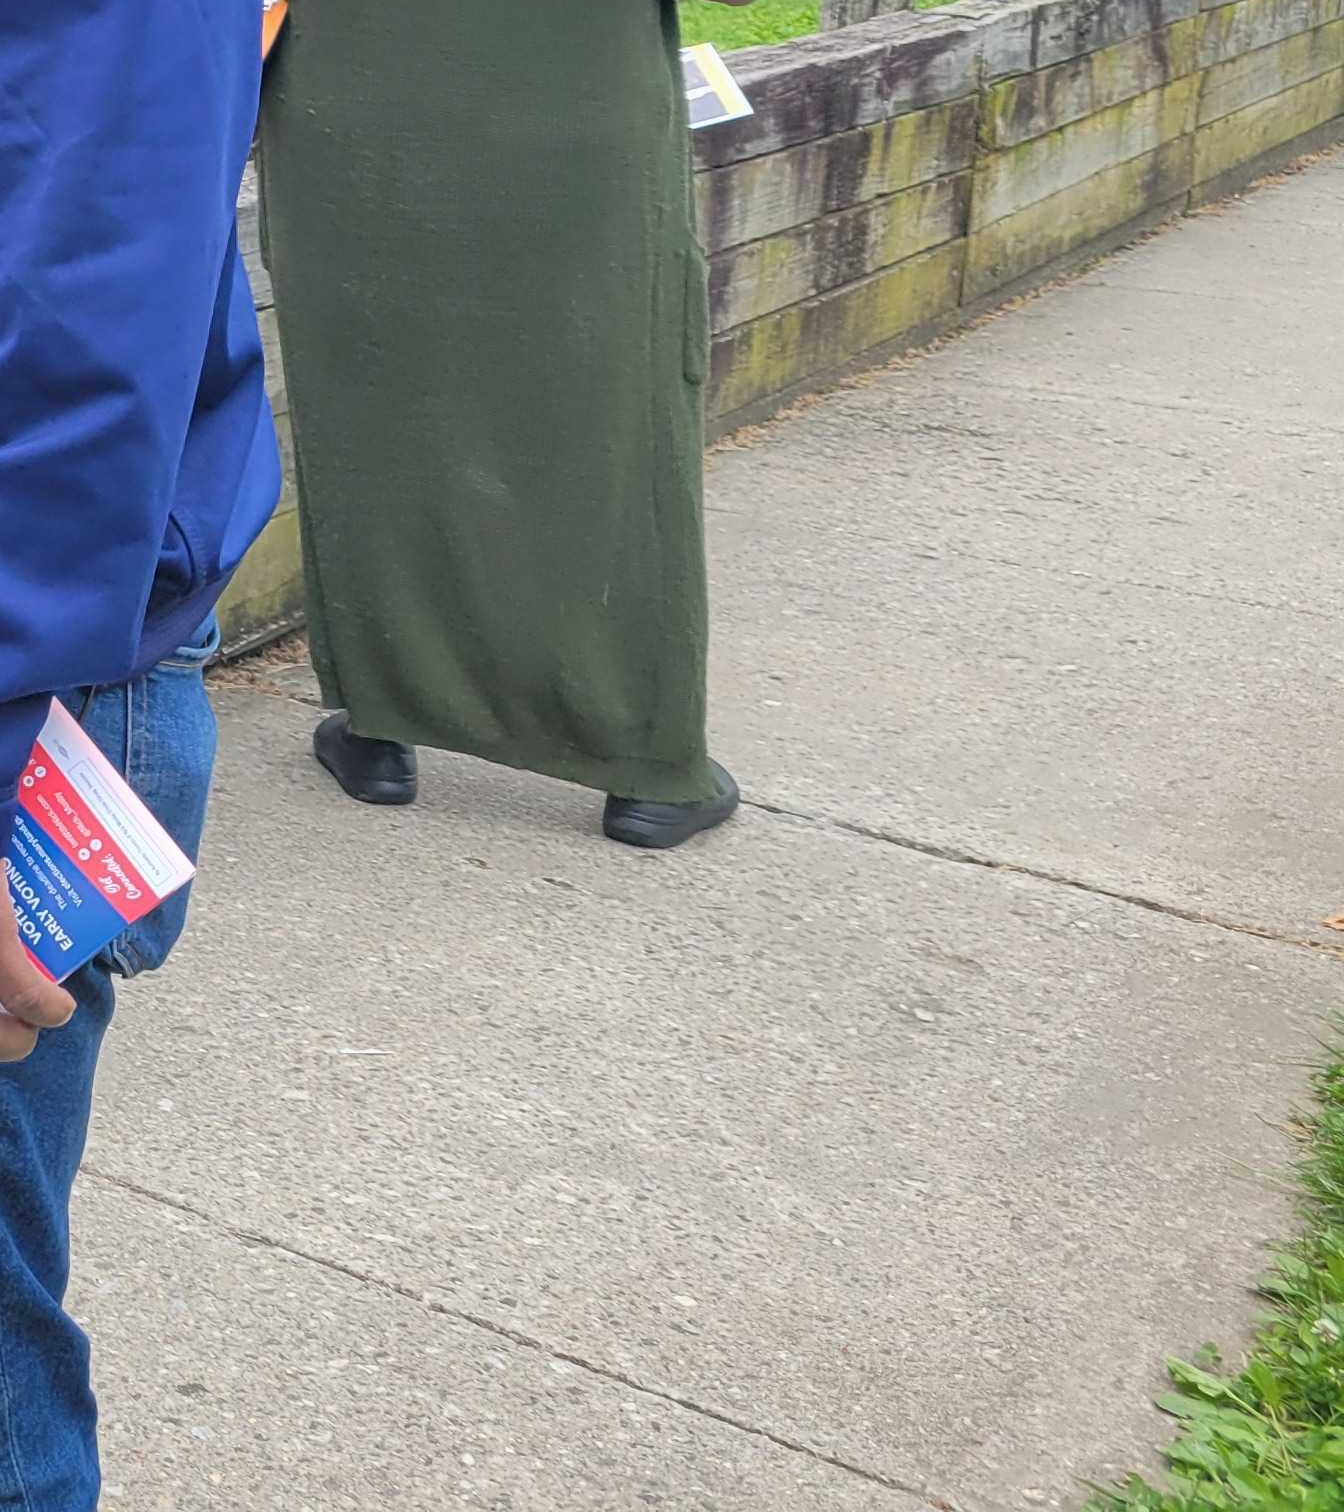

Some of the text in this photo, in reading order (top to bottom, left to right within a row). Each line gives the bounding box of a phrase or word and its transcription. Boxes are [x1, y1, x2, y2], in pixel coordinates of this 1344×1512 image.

[33, 861, 60, 895] deadline
[55, 890, 68, 911] The
[13, 900, 43, 946] VOTE
[35, 906, 74, 953] EARLY
